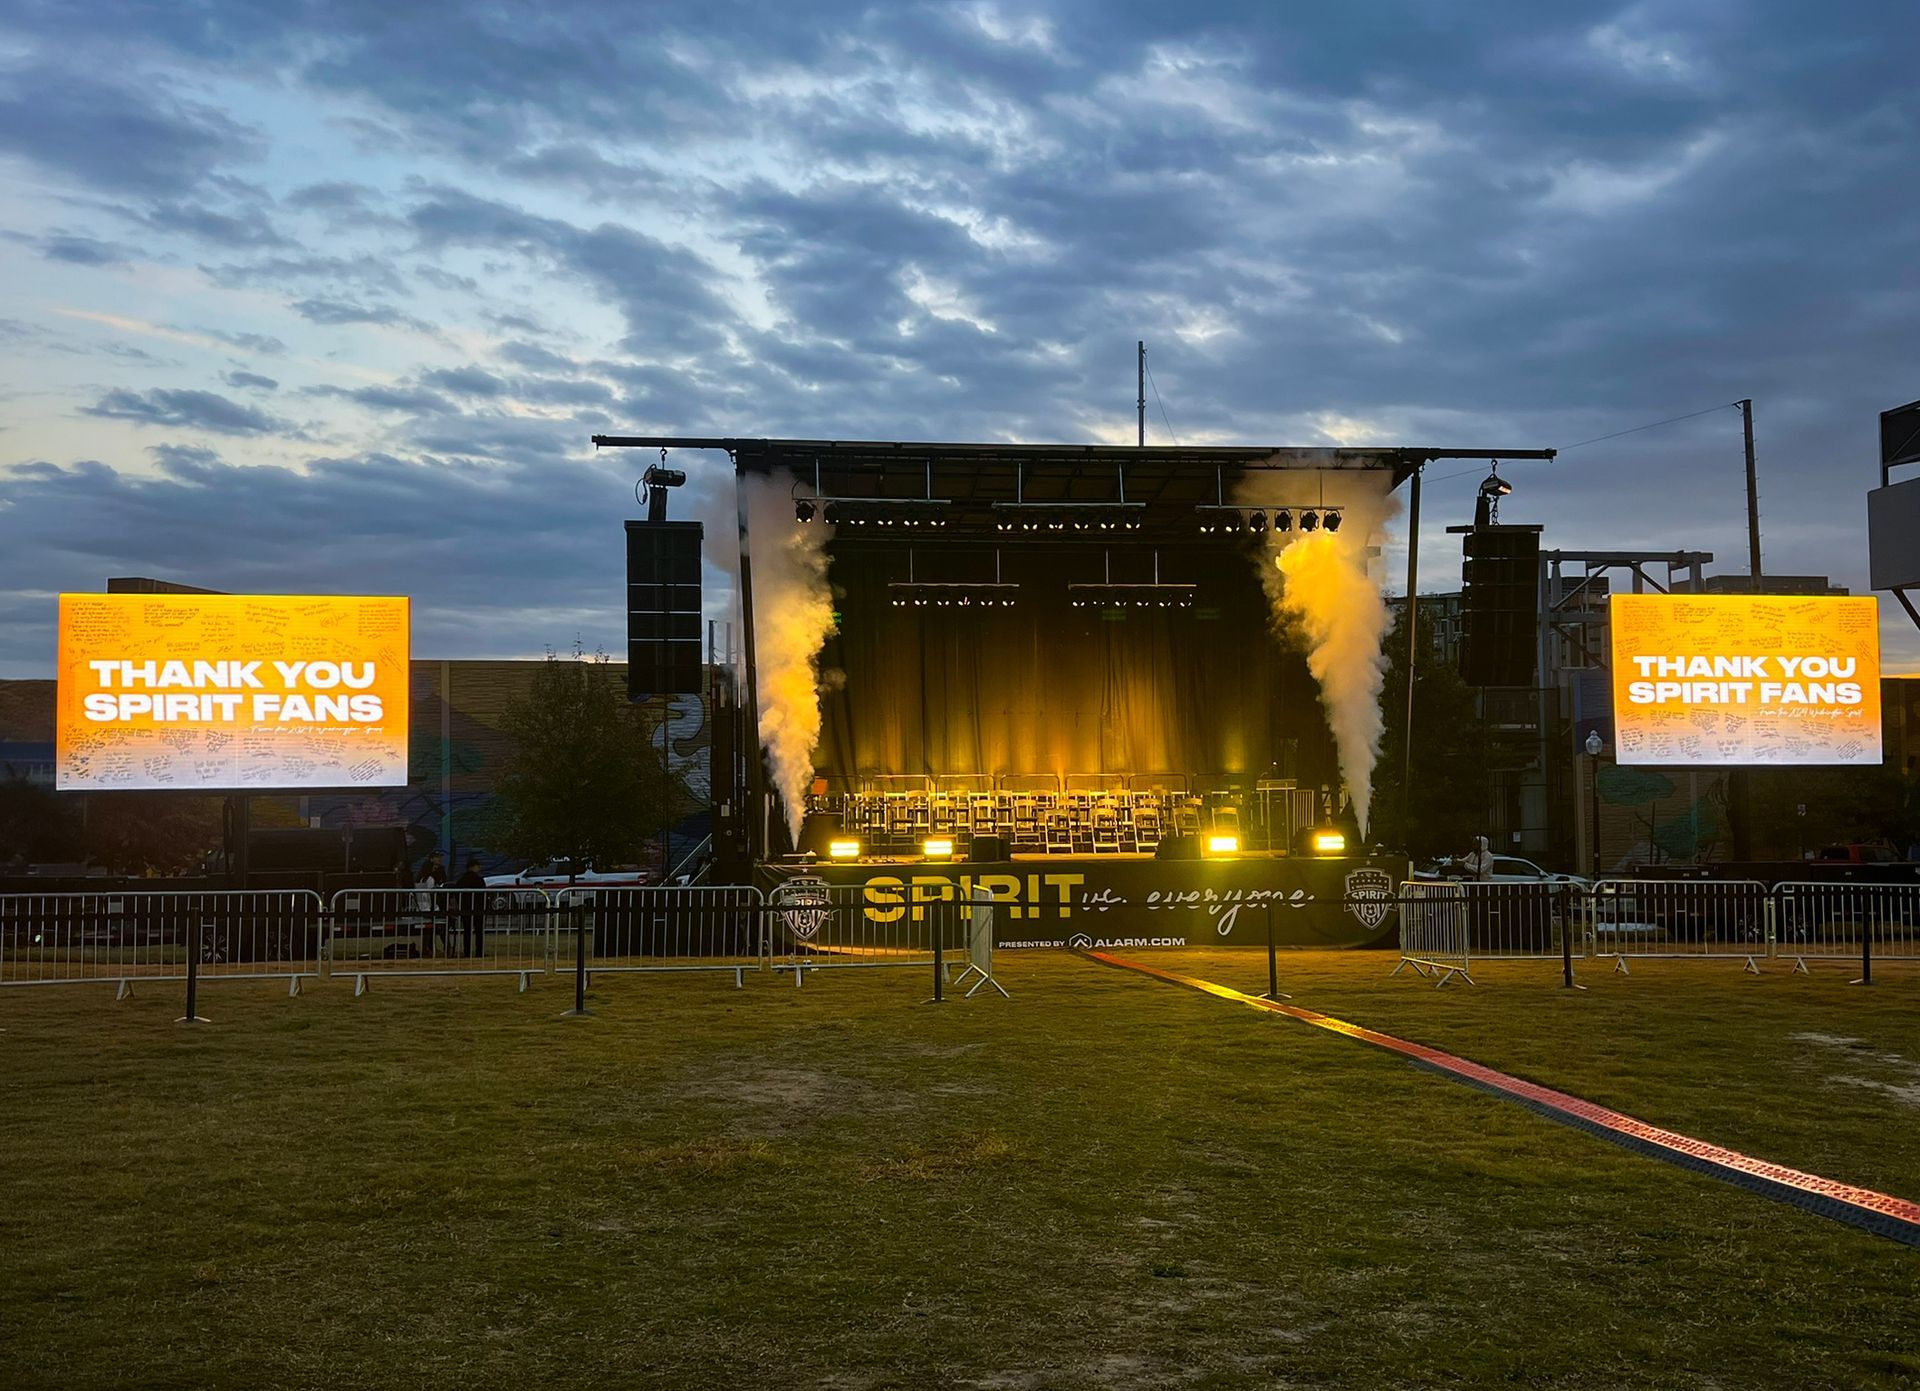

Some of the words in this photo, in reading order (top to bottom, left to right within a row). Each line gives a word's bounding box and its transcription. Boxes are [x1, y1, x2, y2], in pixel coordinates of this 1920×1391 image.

[89, 660, 263, 688] THANK
[274, 660, 375, 689] YOU
[1632, 655, 1769, 678] THANK
[1776, 656, 1856, 679] YOU
[1628, 681, 1753, 704] SPIRIT
[1760, 682, 1862, 705] FANS
[83, 693, 243, 722] SPIRIT
[253, 694, 384, 722] FANS
[863, 874, 1085, 923] SPIRIT
[1351, 890, 1388, 900] SPIRIT
[999, 940, 1052, 948] PRESENTED
[1094, 937, 1187, 948] ALARM.COM
